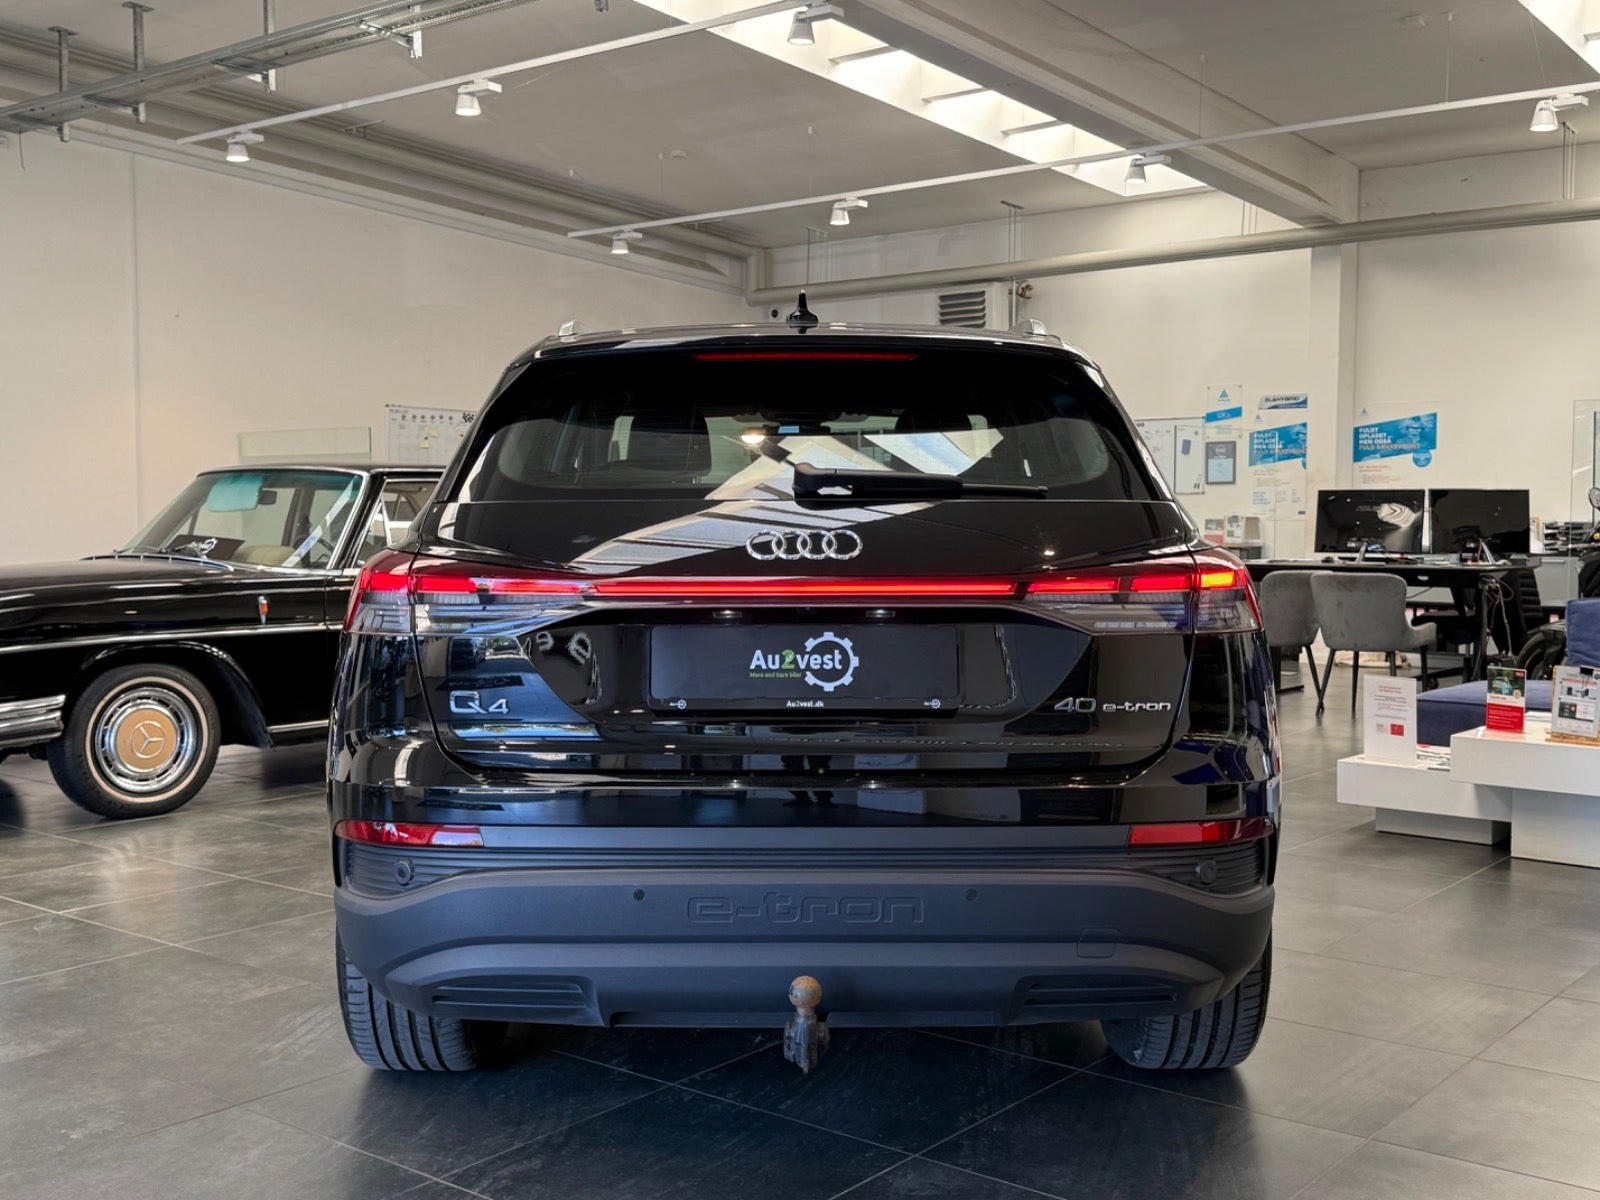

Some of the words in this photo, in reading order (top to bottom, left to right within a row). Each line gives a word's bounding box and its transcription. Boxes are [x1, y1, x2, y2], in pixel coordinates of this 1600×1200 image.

[750, 649, 842, 670] Au2vest
[786, 700, 825, 708] Au2vest.dk
[1054, 697, 1097, 712] 40
[1102, 701, 1171, 712] e-tron
[687, 892, 924, 923] e-tron
